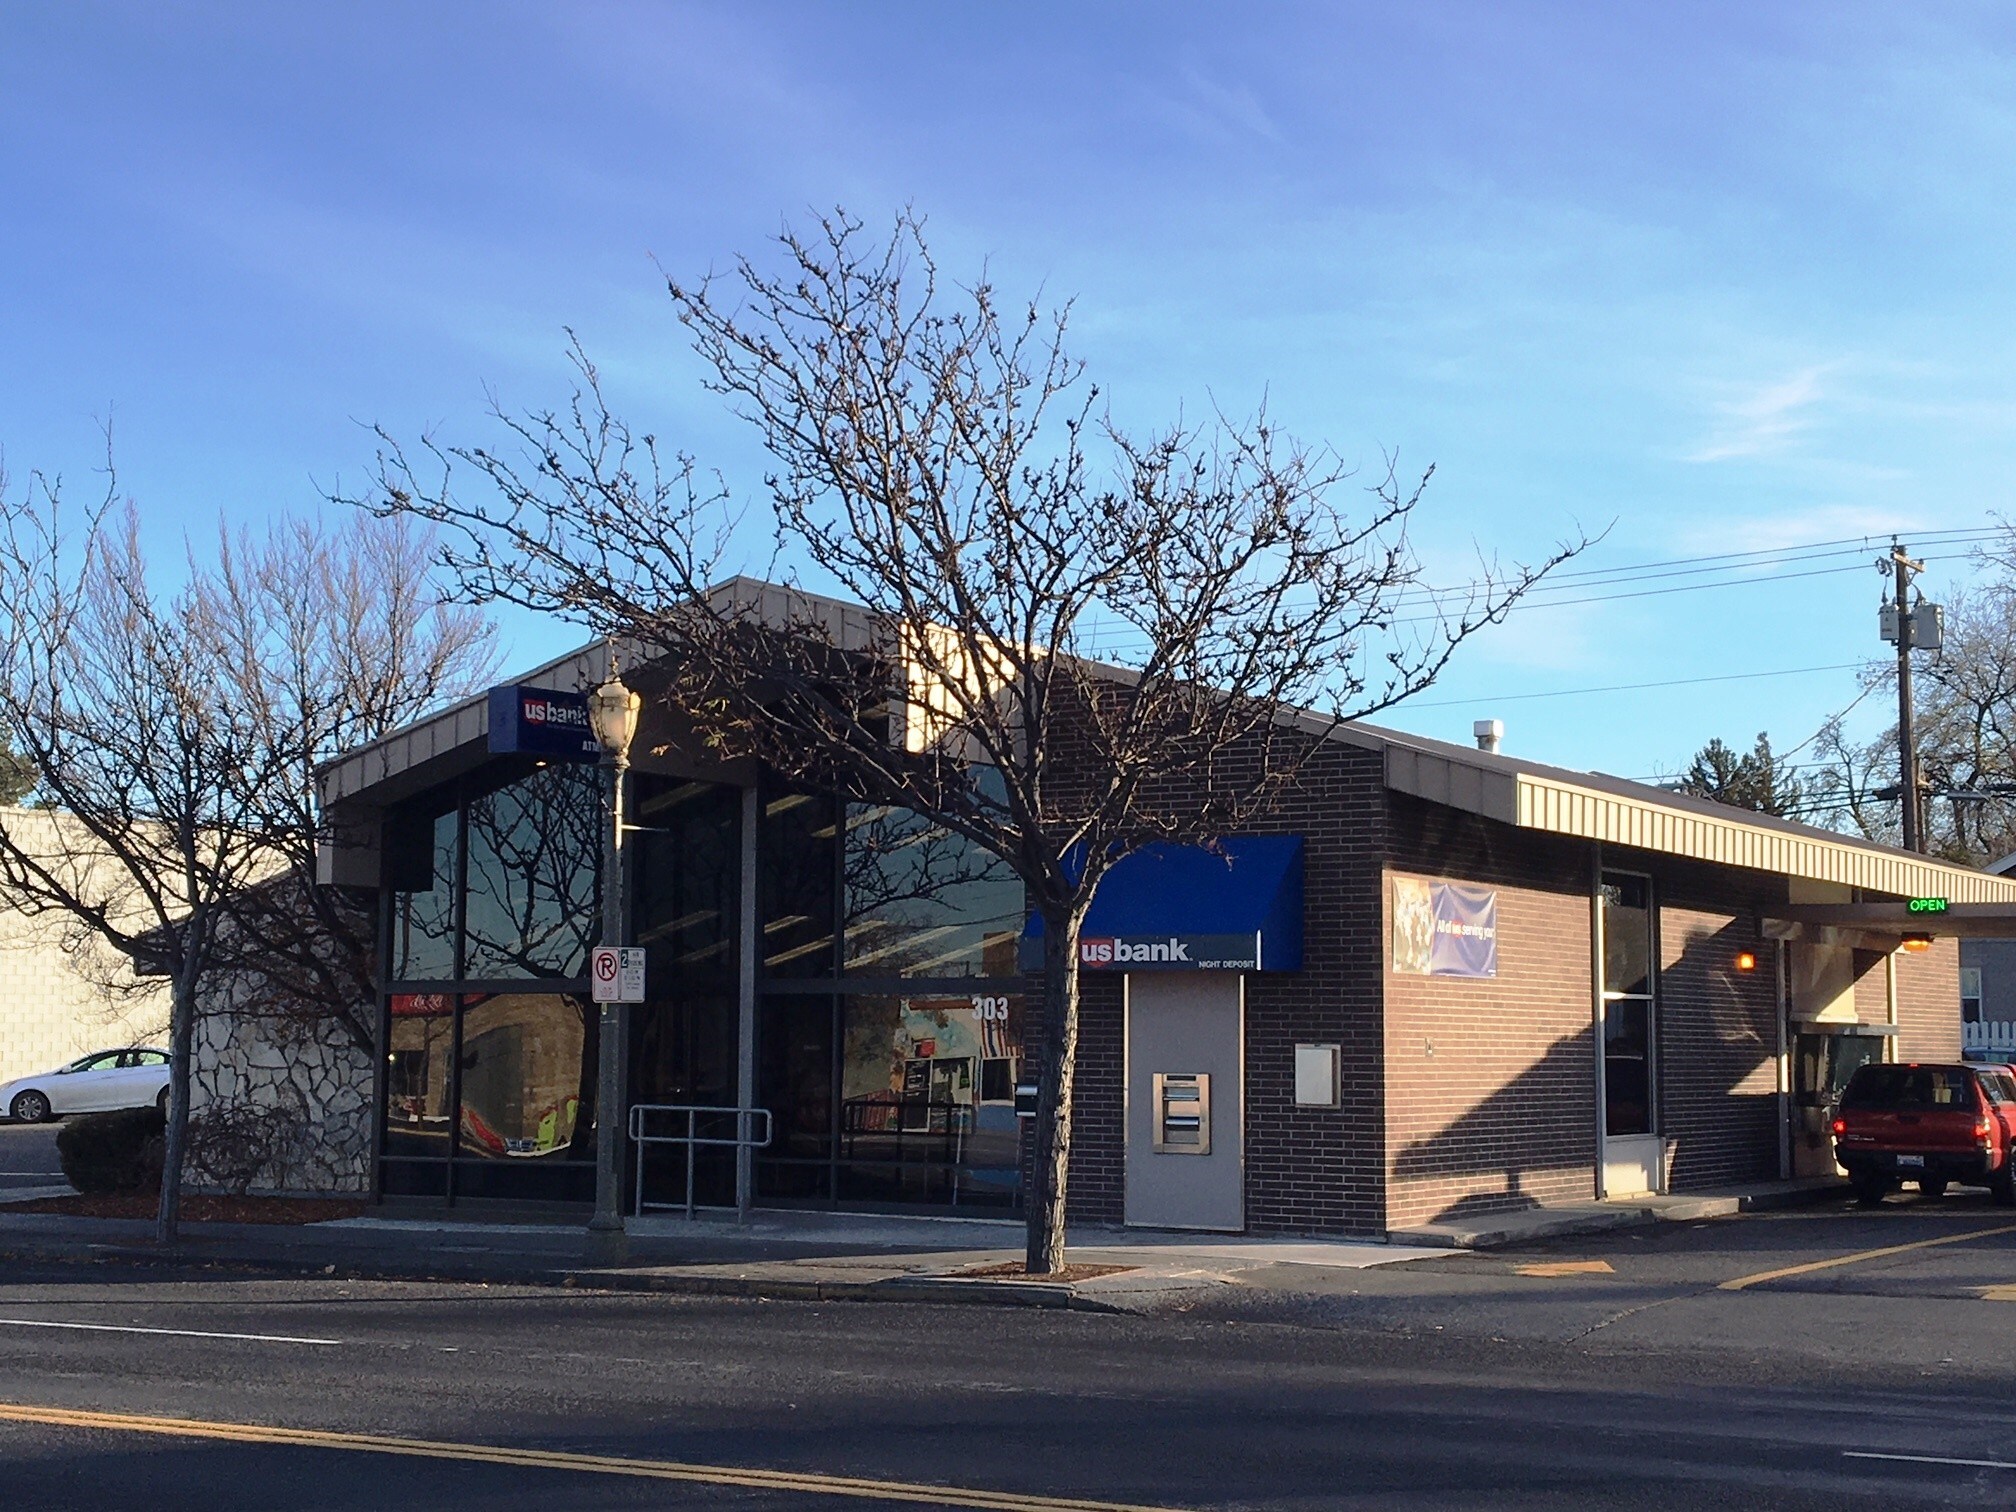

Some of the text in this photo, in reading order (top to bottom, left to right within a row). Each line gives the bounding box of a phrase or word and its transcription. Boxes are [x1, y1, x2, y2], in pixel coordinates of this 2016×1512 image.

[1909, 899, 1946, 912] OPEN
[1461, 922, 1484, 941] serving
[1081, 937, 1189, 962] usbank
[621, 953, 628, 967] 2
[1198, 960, 1255, 968] NIGHT DEPOSIT
[971, 996, 1009, 1020] 303
